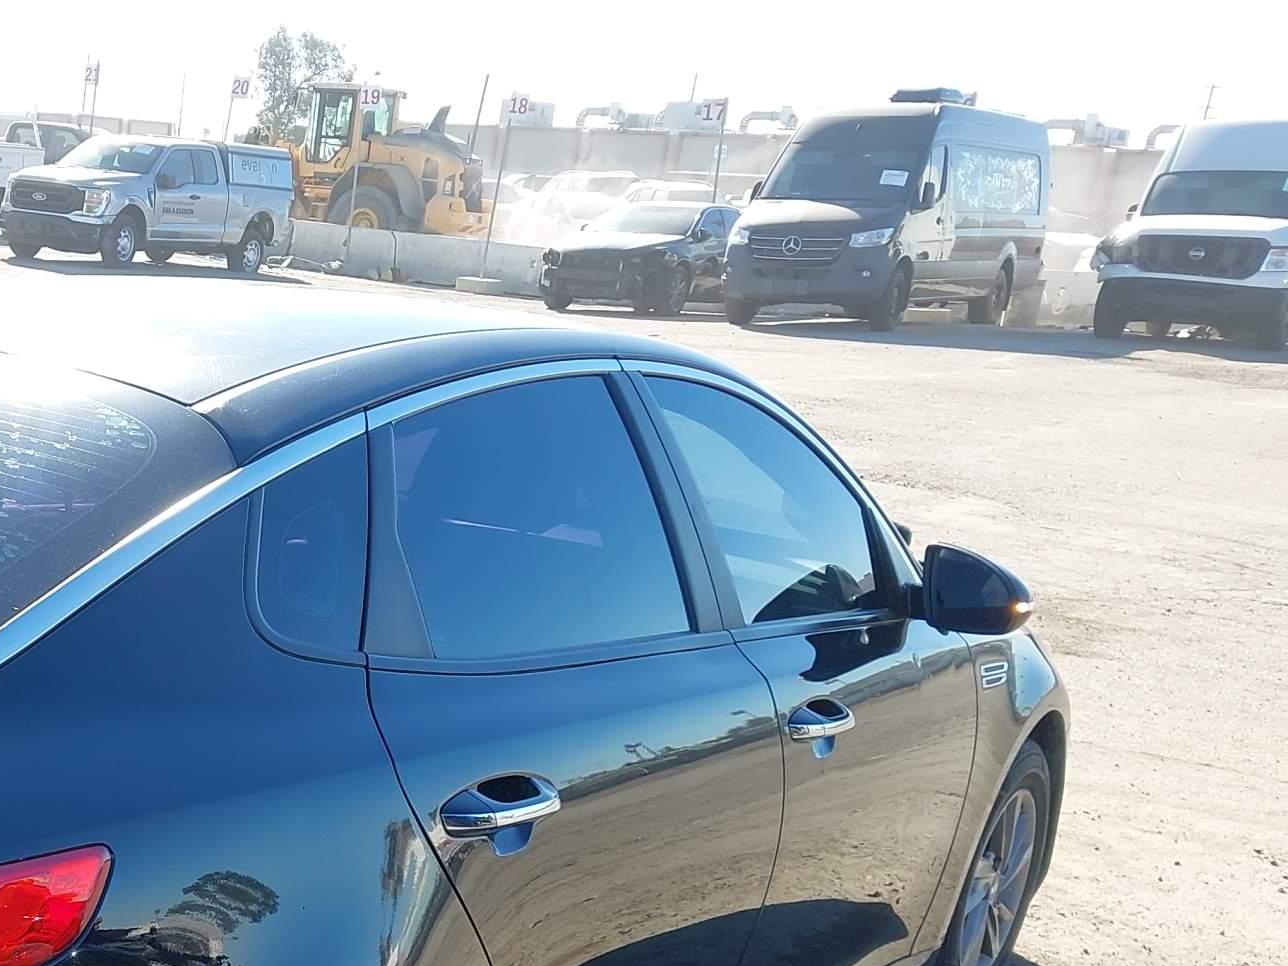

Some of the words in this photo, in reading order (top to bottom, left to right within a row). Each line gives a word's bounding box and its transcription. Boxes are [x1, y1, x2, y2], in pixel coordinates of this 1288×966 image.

[232, 79, 249, 95] 20
[361, 89, 380, 105] 19
[509, 97, 529, 114] 18
[702, 103, 726, 121] 17
